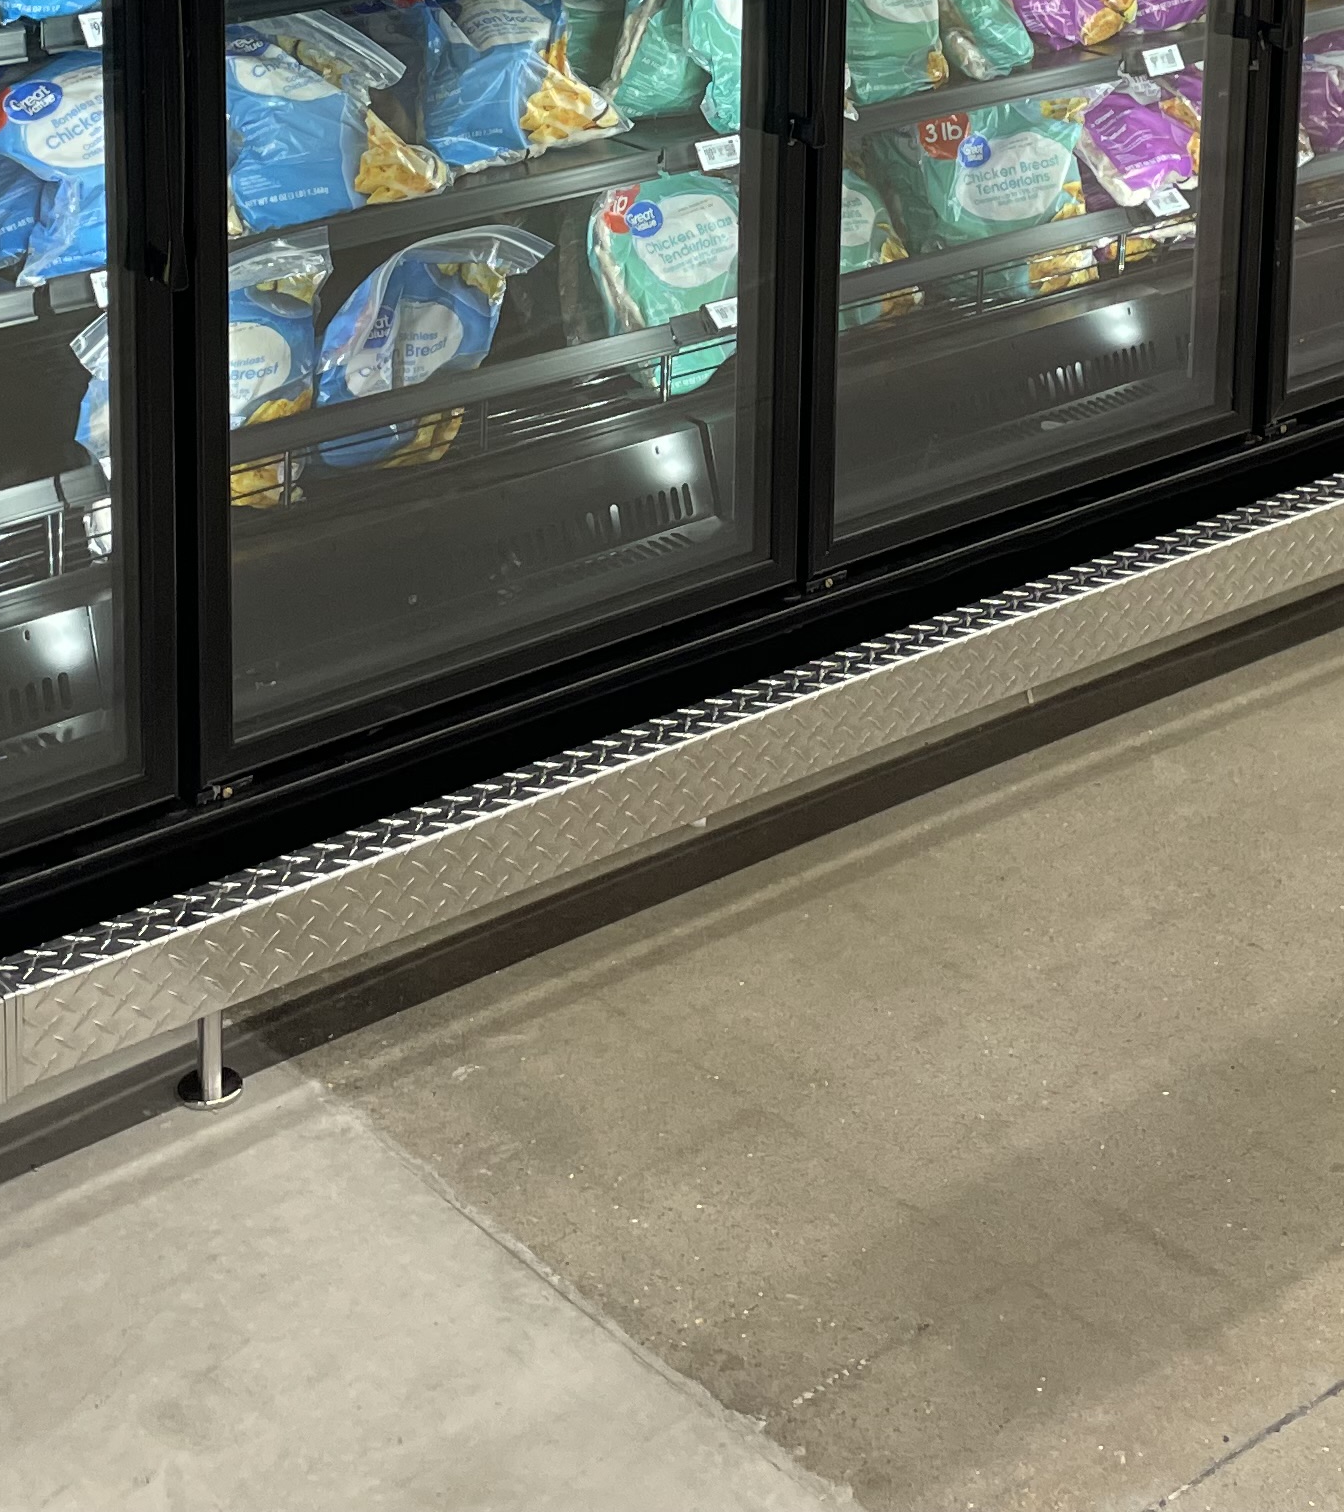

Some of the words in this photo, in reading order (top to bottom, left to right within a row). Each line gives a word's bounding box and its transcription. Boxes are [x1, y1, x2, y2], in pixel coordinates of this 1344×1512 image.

[9, 84, 51, 112] Great
[45, 110, 104, 150] Chicke
[924, 123, 938, 144] 3
[941, 121, 963, 141] lb
[963, 165, 1018, 186] Chicken
[1019, 155, 1060, 174] Breast
[975, 171, 1051, 196] Tenderloins
[626, 207, 656, 225] Great
[644, 229, 696, 255] Chicken
[405, 339, 447, 358] Breast
[230, 361, 279, 381] Breast
